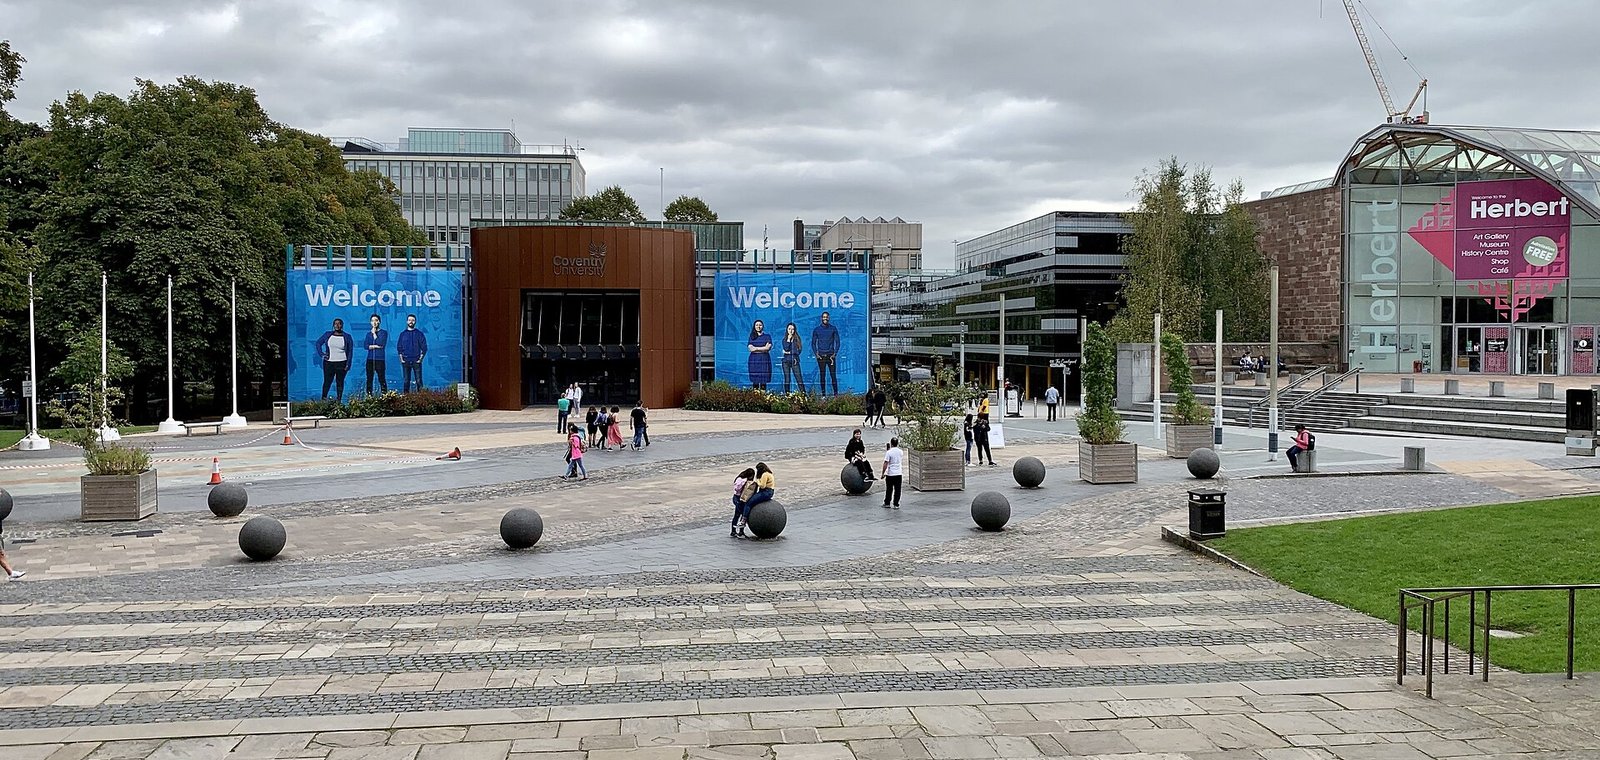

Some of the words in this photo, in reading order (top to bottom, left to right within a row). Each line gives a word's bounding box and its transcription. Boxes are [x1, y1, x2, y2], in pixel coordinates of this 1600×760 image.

[1471, 196, 1569, 219] Herbert
[1484, 233, 1510, 241] Gallery
[553, 255, 605, 269] Coventry
[1525, 246, 1553, 262] FREE
[553, 265, 605, 278] University
[1361, 199, 1398, 354] Herbert
[1490, 266, 1509, 274] Café
[304, 284, 441, 307] Welcome
[728, 286, 855, 309] Welcome
